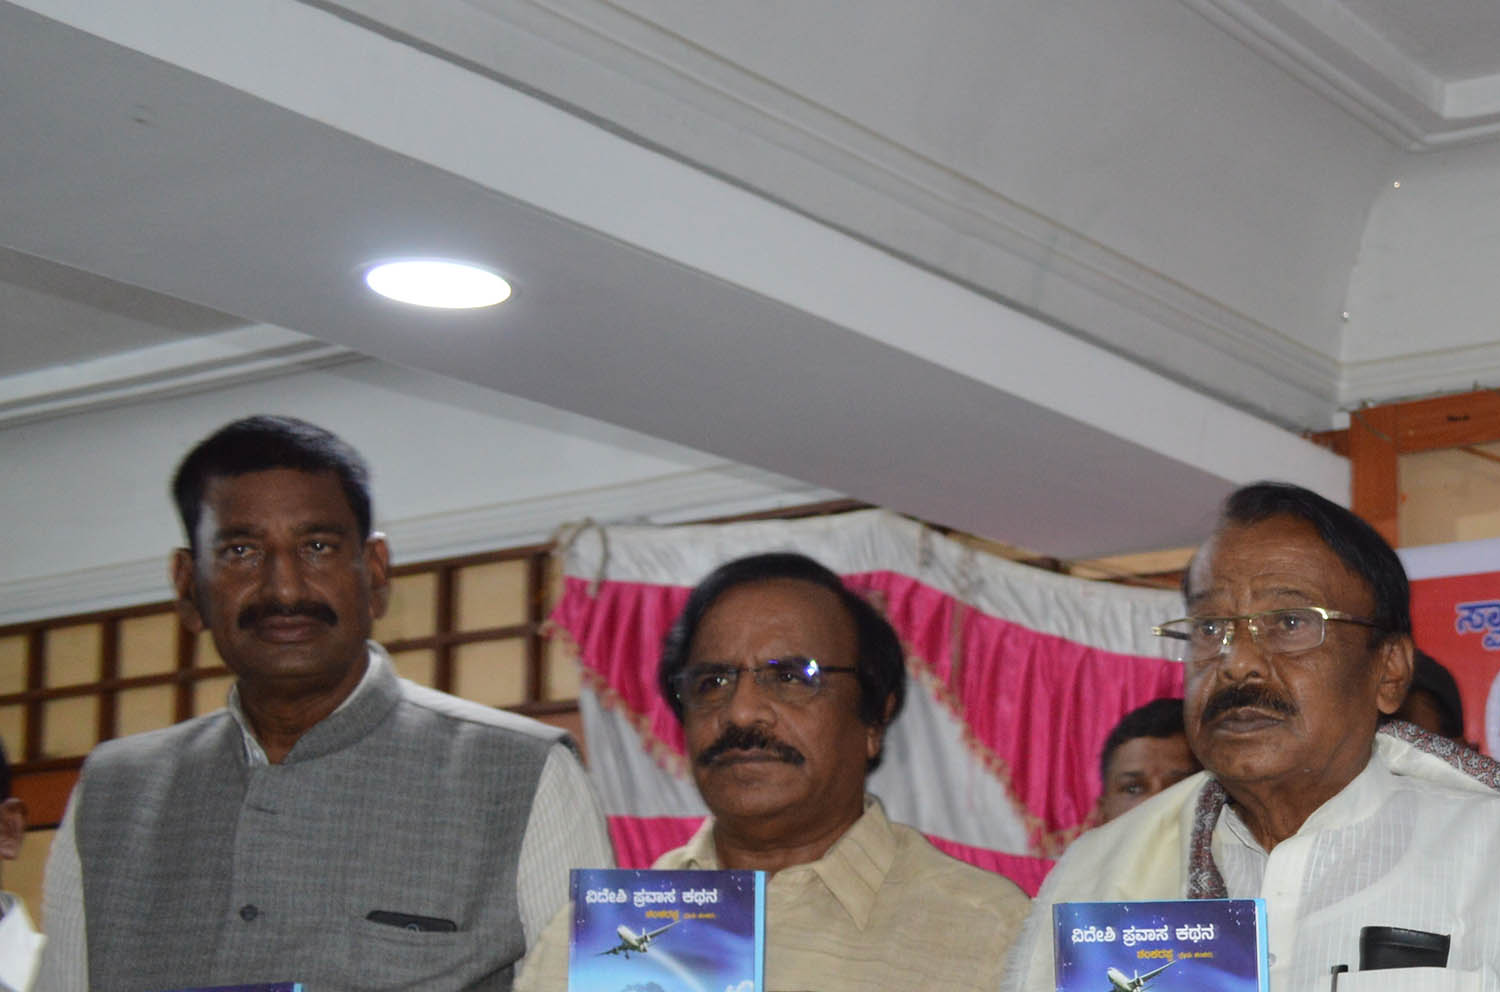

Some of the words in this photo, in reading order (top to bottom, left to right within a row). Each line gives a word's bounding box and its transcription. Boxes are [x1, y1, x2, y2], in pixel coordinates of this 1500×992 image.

[586, 887, 627, 904] ವಿದೇಶಿ
[633, 888, 676, 907] ಪ್ರವಾಸ
[682, 887, 718, 906] ಕಥನ
[1071, 925, 1116, 944] ವಿದೇಶಿ
[1122, 924, 1169, 947] ಪ್ರವಾಸ
[1175, 922, 1215, 943] ಕಥನ
